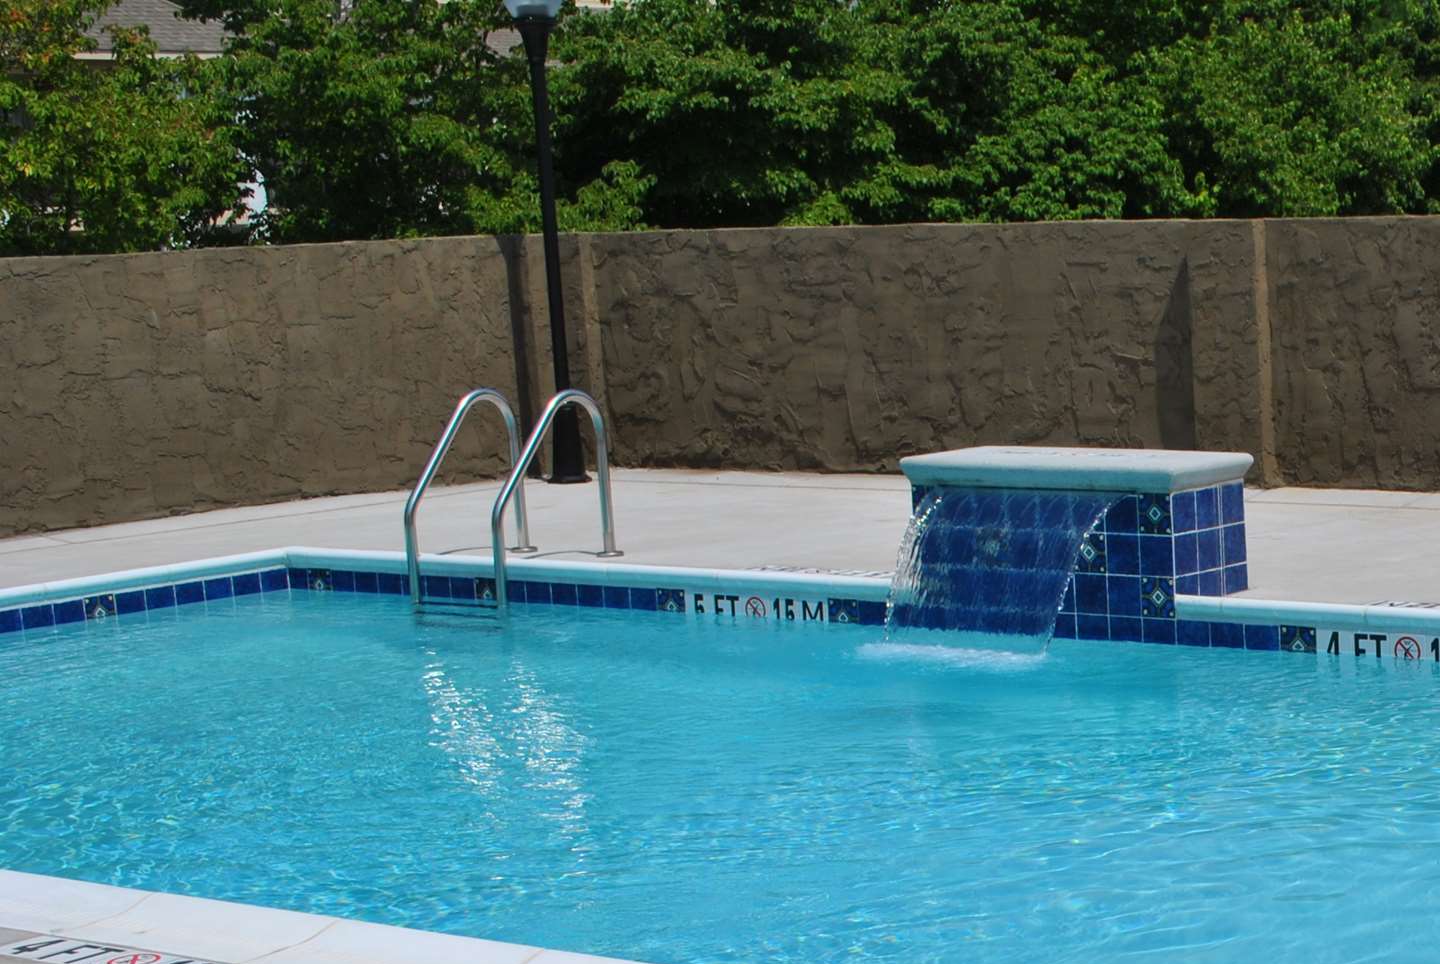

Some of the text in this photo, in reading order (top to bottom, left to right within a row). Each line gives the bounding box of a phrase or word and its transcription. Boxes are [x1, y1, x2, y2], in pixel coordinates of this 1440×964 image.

[714, 594, 740, 617] FT
[802, 599, 824, 622] M
[1353, 633, 1387, 658] FT
[12, 939, 66, 955] 4
[36, 944, 126, 964] FT
